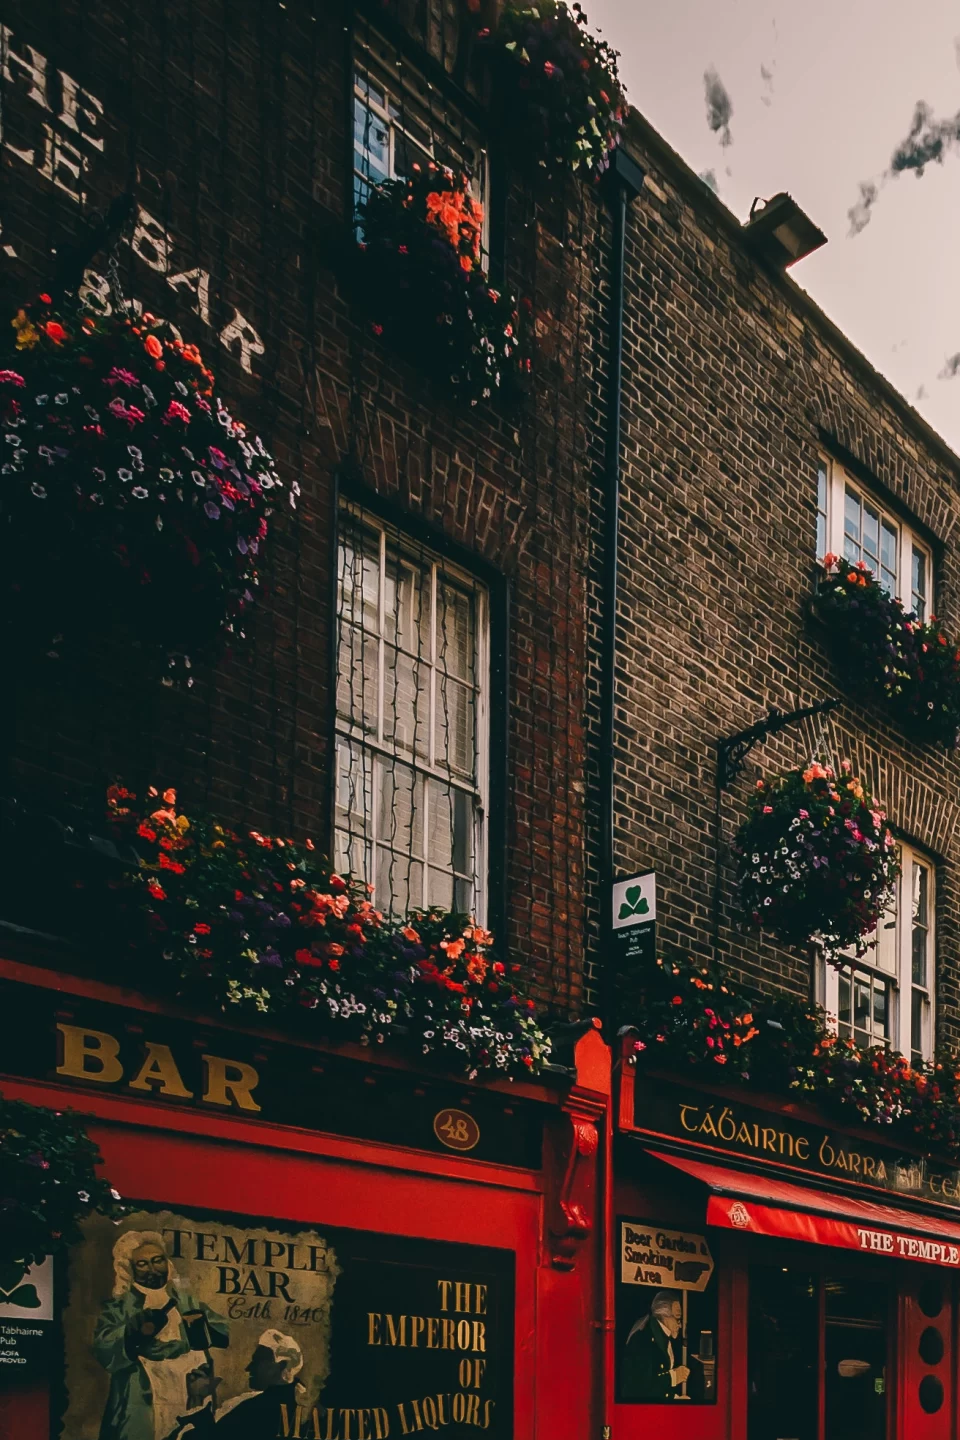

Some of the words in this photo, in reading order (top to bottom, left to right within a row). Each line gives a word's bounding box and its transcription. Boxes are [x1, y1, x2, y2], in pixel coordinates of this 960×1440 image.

[56, 1022, 262, 1112] BAR
[440, 1114, 469, 1142] 48
[162, 1228, 330, 1273] TEMPLE
[624, 1246, 674, 1272] Smoking
[625, 1227, 652, 1246] Beer
[656, 1232, 697, 1255] Garden
[858, 1229, 894, 1252] THE
[897, 1237, 960, 1265] TEMPLE
[216, 1265, 296, 1304] BAR
[634, 1266, 662, 1285] Area
[437, 1279, 488, 1316] THE
[0, 1336, 17, 1345] Pub
[367, 1311, 488, 1353] EMPEROR
[458, 1358, 487, 1389] OF
[397, 1392, 497, 1436] LIQUORS
